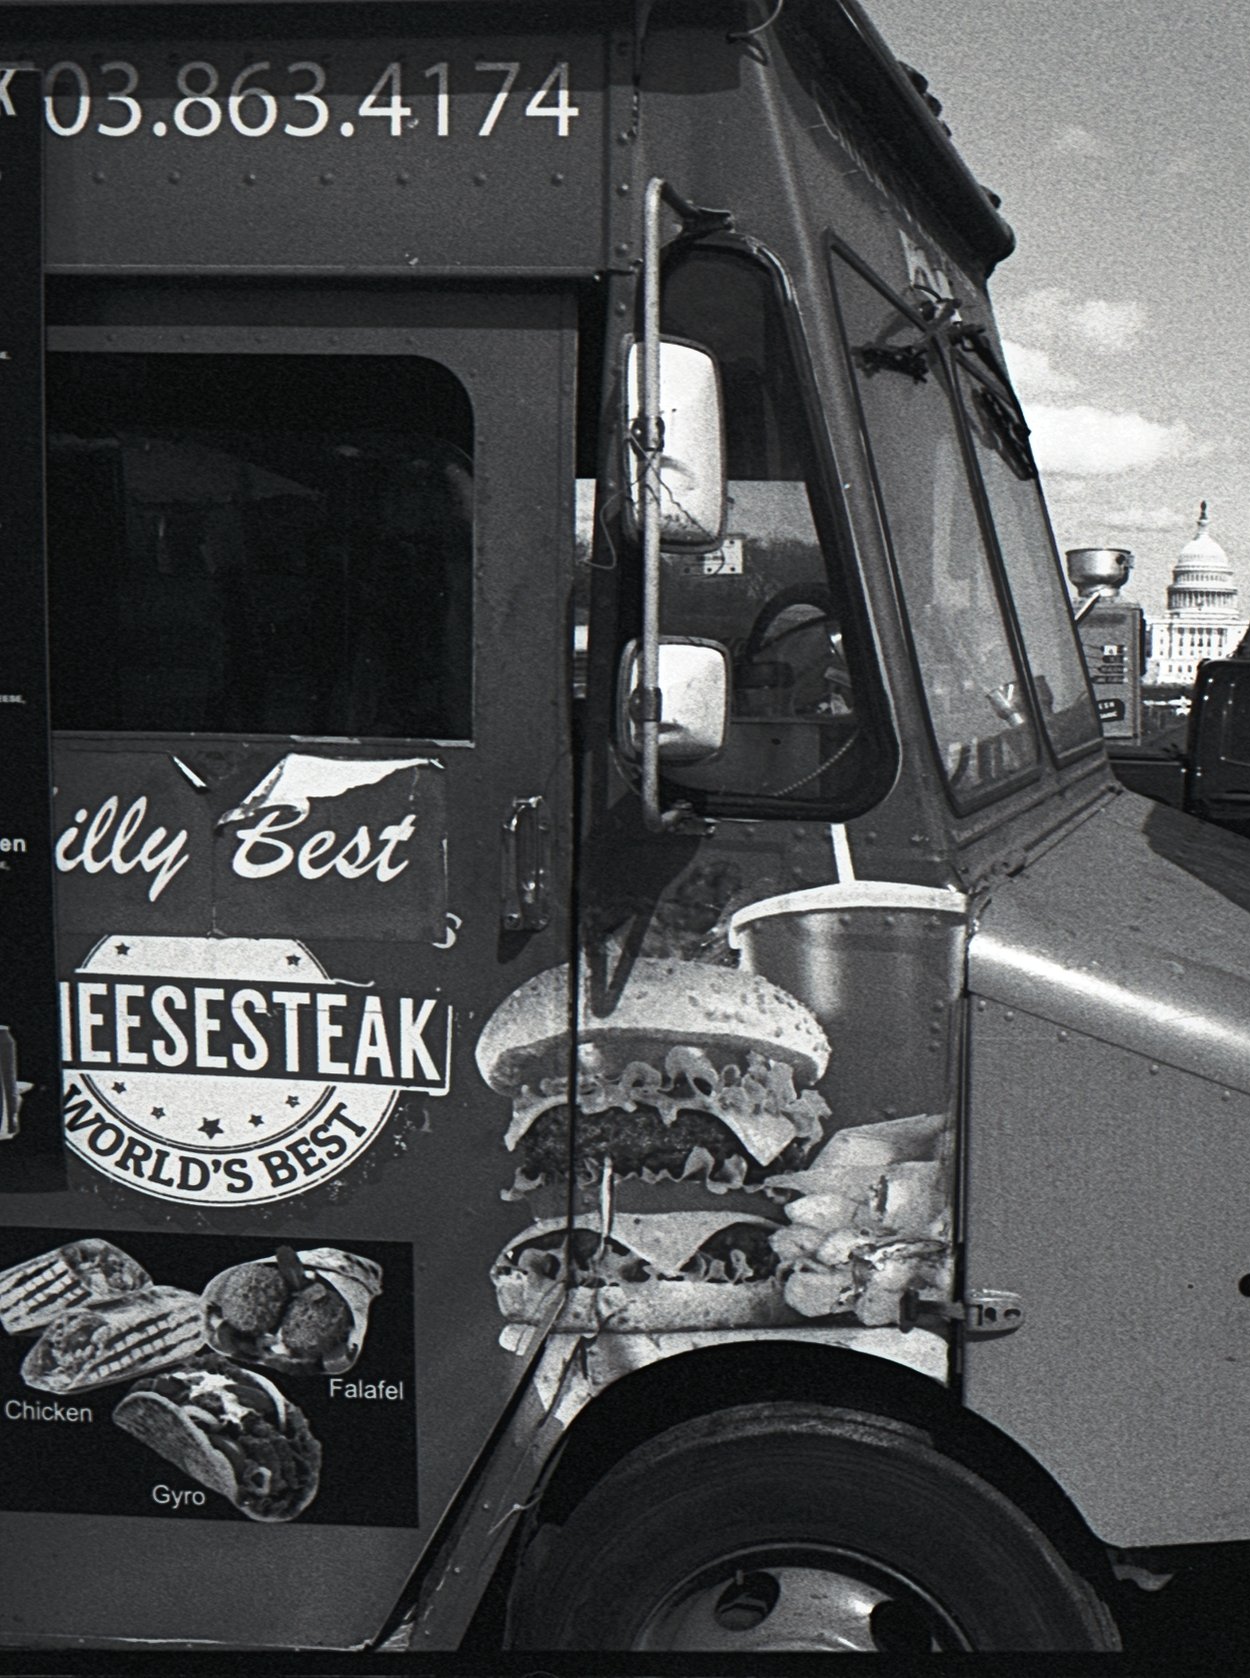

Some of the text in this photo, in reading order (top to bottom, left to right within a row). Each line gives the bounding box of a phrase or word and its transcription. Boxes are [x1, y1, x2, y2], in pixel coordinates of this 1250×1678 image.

[2, 59, 579, 138] 03.863.4174
[232, 803, 417, 883] Best
[65, 1082, 368, 1195] WORLD'S BEST
[4, 1399, 93, 1423] Chicken
[329, 1378, 404, 1401] Falafel
[152, 1483, 206, 1509] Gyro
